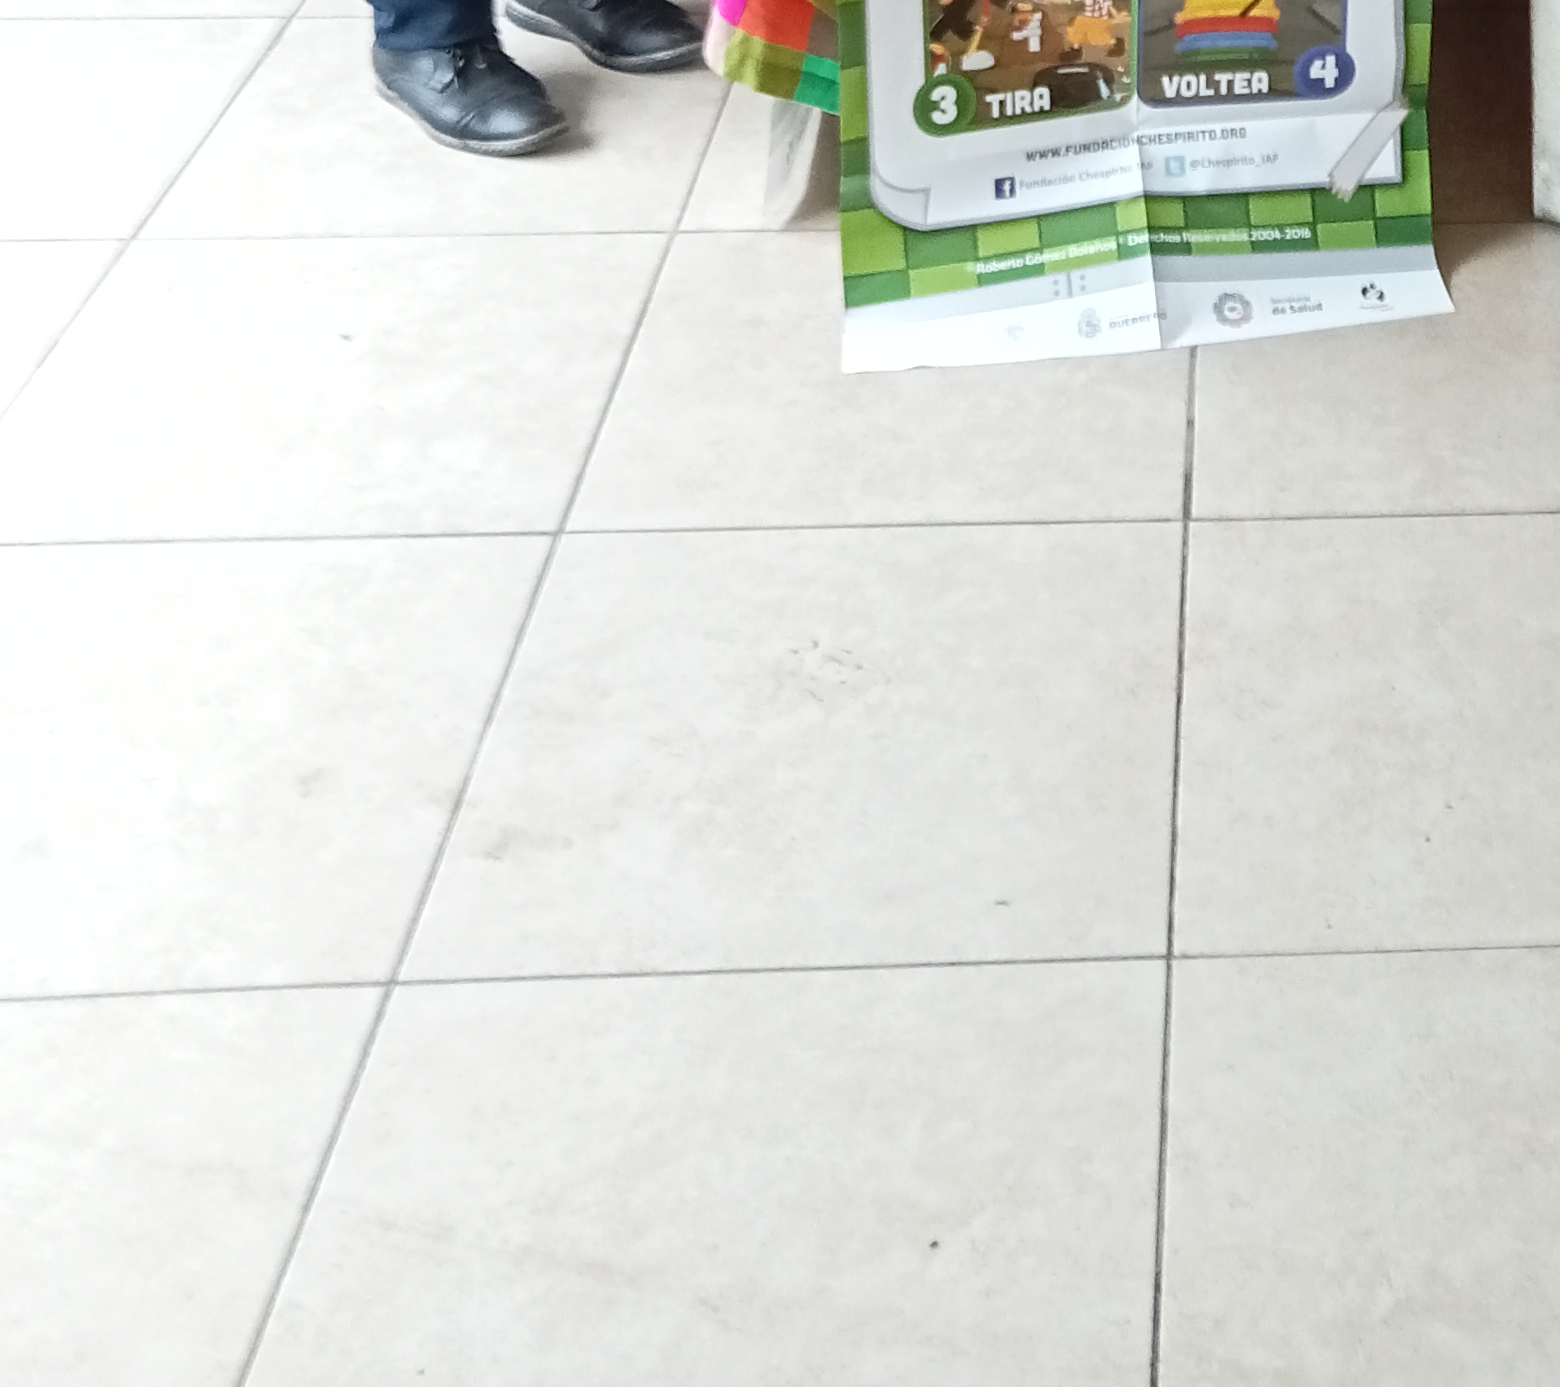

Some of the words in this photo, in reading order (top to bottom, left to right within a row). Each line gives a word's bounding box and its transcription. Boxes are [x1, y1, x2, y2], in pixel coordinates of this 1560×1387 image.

[1161, 72, 1269, 98] VOLTEA
[1310, 54, 1339, 89] 4
[929, 85, 959, 125] 3
[985, 86, 1051, 119] TIRA
